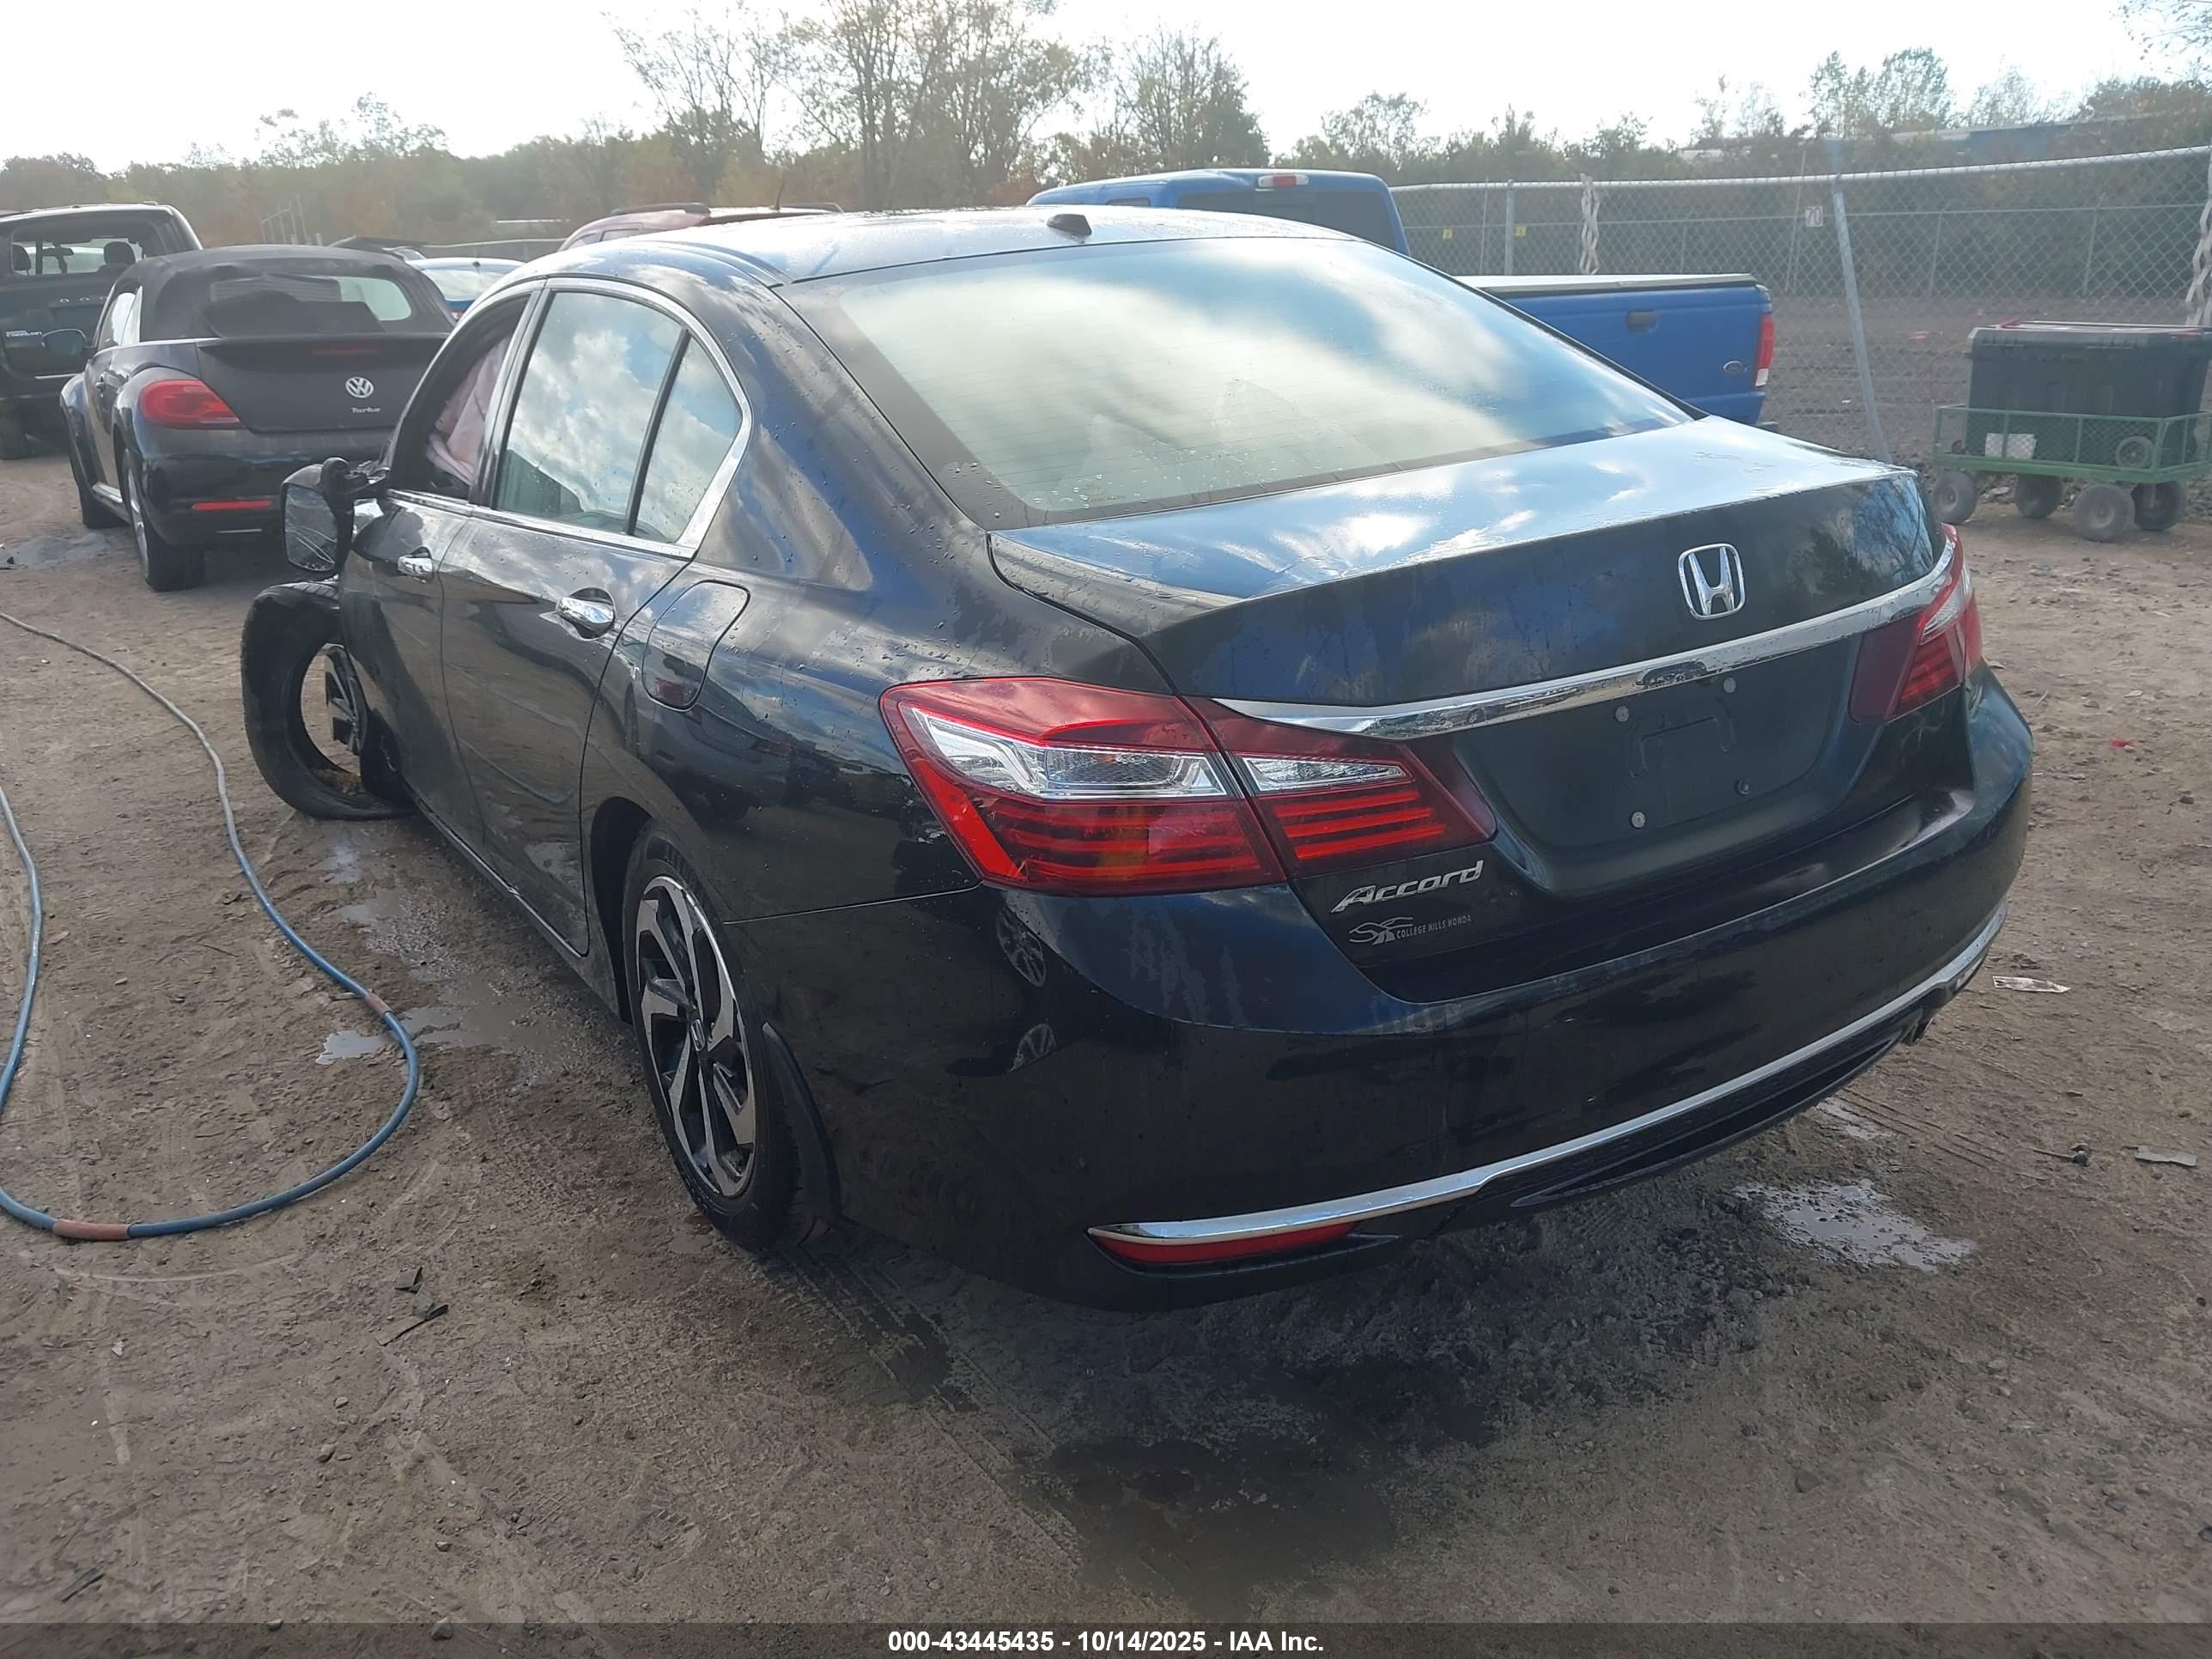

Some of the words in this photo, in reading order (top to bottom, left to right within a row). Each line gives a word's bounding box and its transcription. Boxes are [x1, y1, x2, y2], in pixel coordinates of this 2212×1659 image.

[1806, 207, 1821, 225] 70
[1331, 860, 1484, 914] Accord
[1396, 923, 1426, 939] COLLEGE
[1428, 919, 1446, 932] HILLS
[1448, 914, 1472, 927] HONDA
